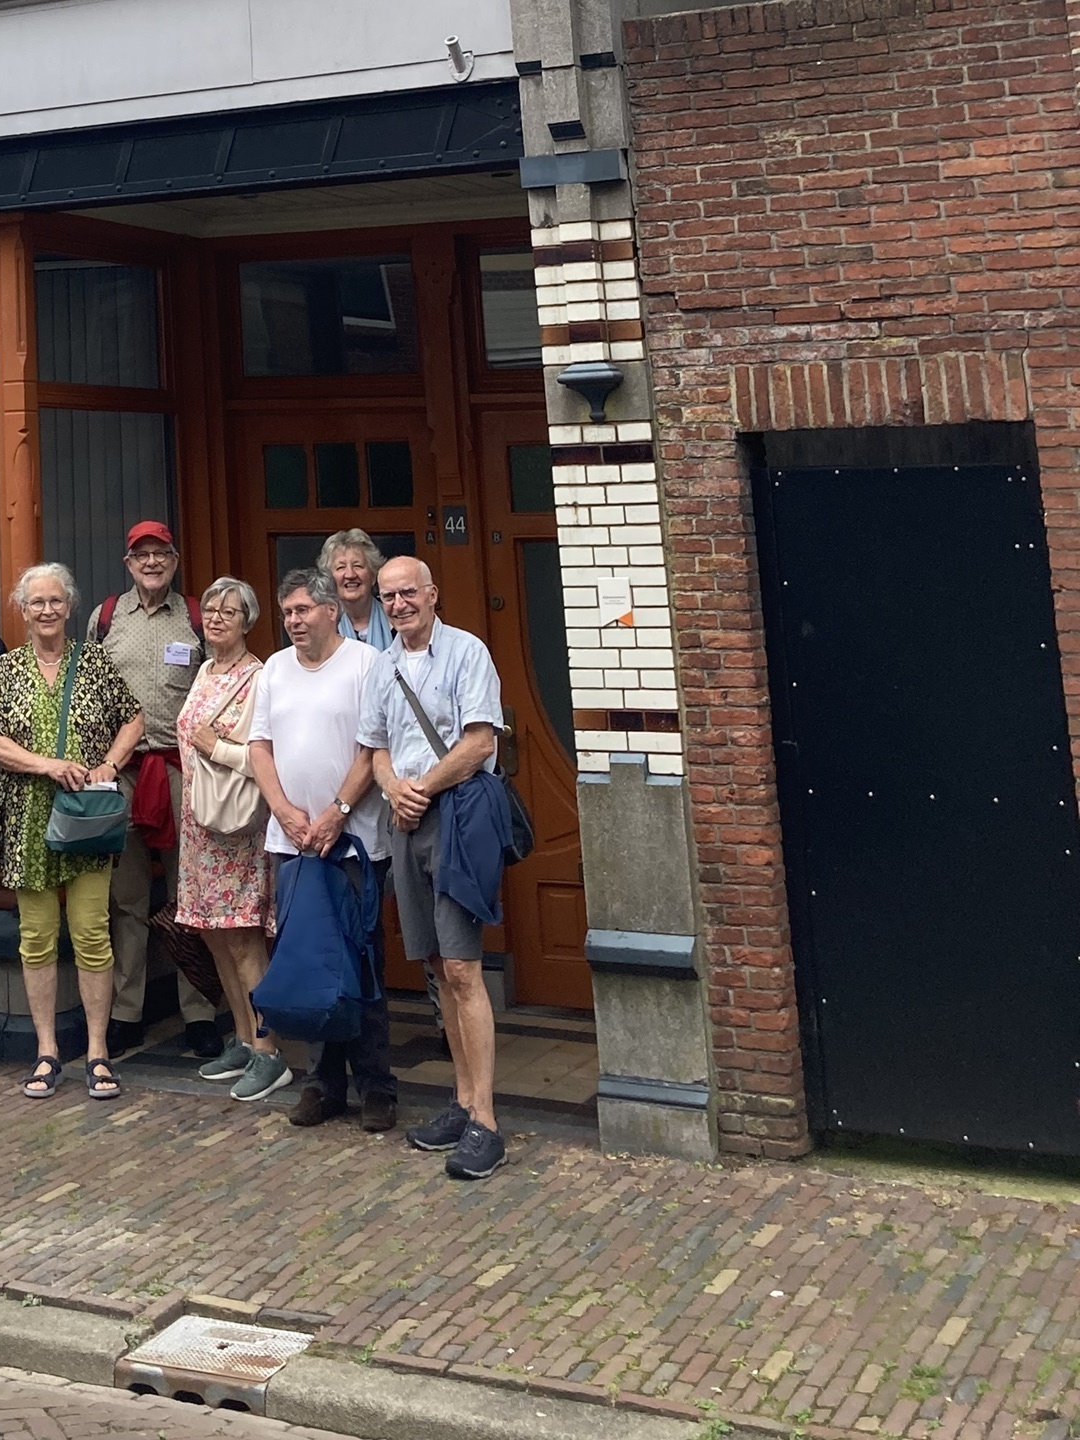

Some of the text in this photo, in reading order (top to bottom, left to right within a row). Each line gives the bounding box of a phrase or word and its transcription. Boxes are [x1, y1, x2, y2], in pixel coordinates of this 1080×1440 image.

[444, 516, 466, 534] 44
[427, 532, 434, 542] A
[493, 532, 500, 543] B
